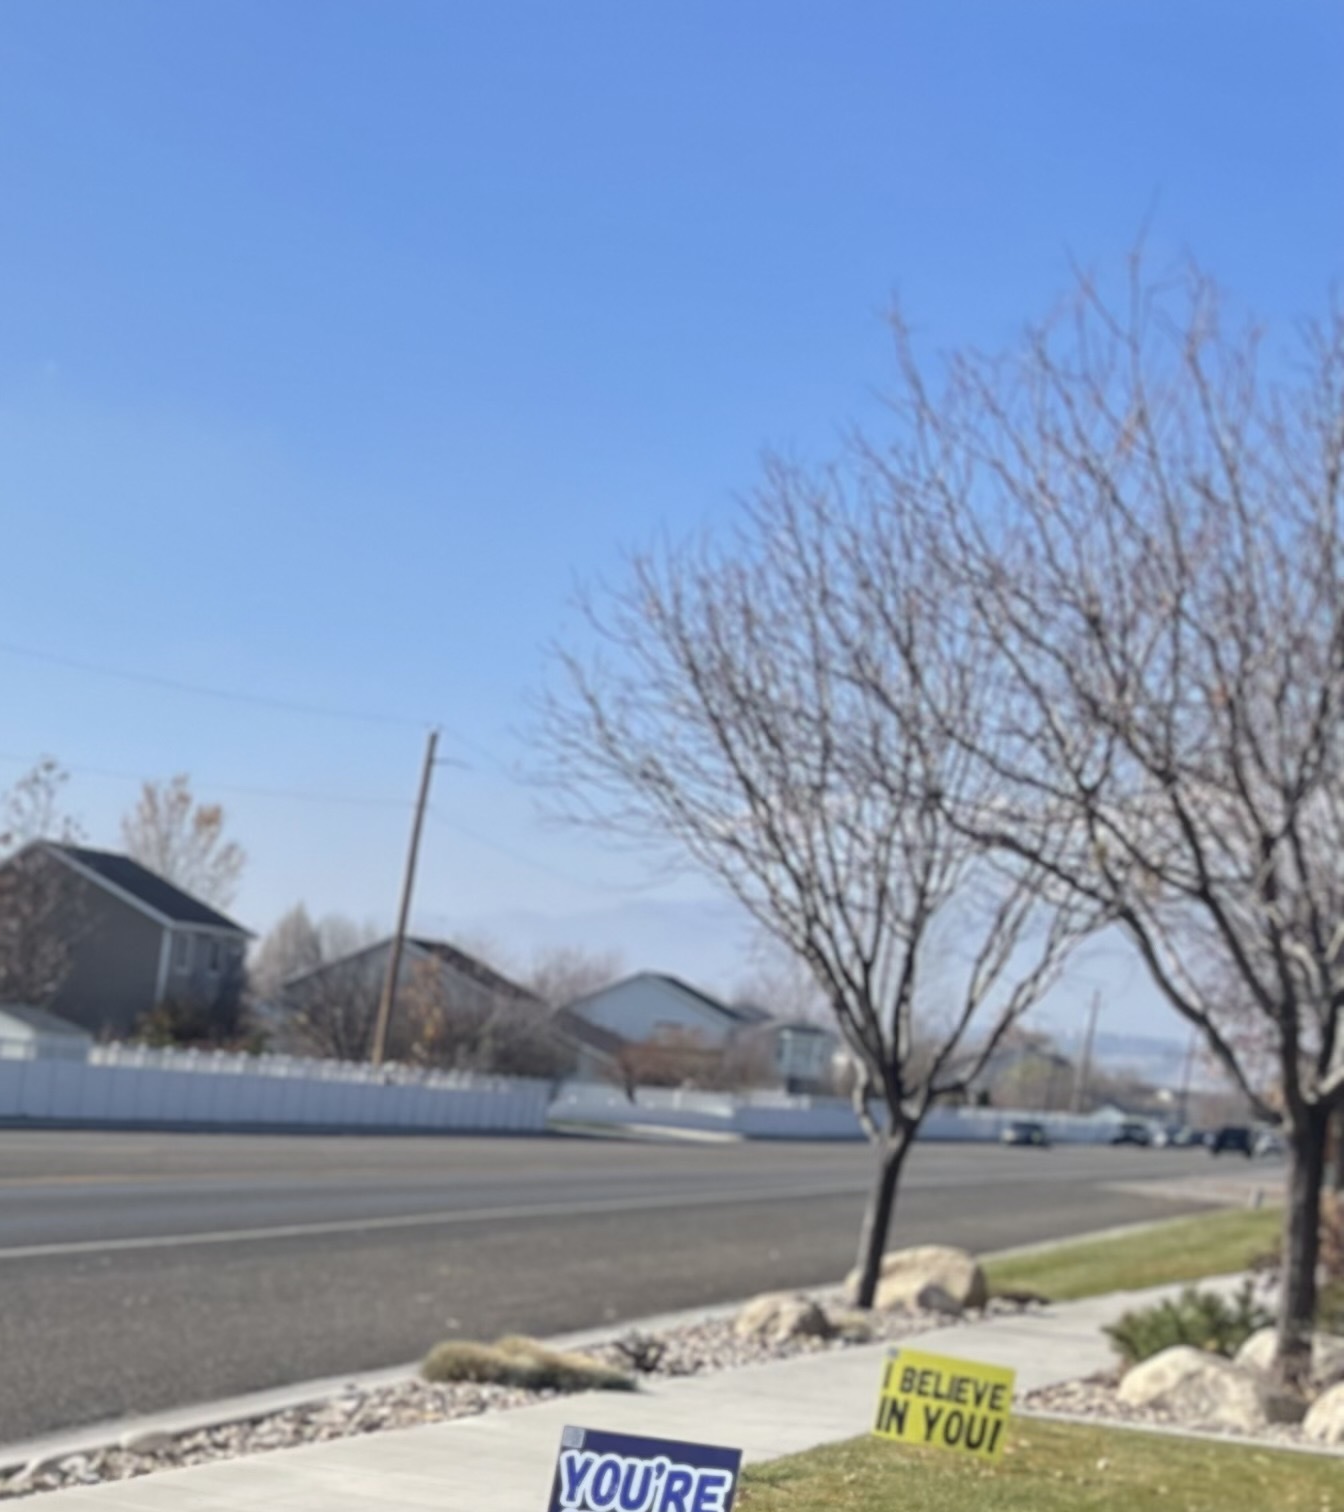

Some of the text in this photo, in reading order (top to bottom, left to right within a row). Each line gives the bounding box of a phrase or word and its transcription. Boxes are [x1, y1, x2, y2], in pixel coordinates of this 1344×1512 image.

[883, 1358, 1008, 1412] I BELIEVE
[875, 1396, 1003, 1454] IN YOU!
